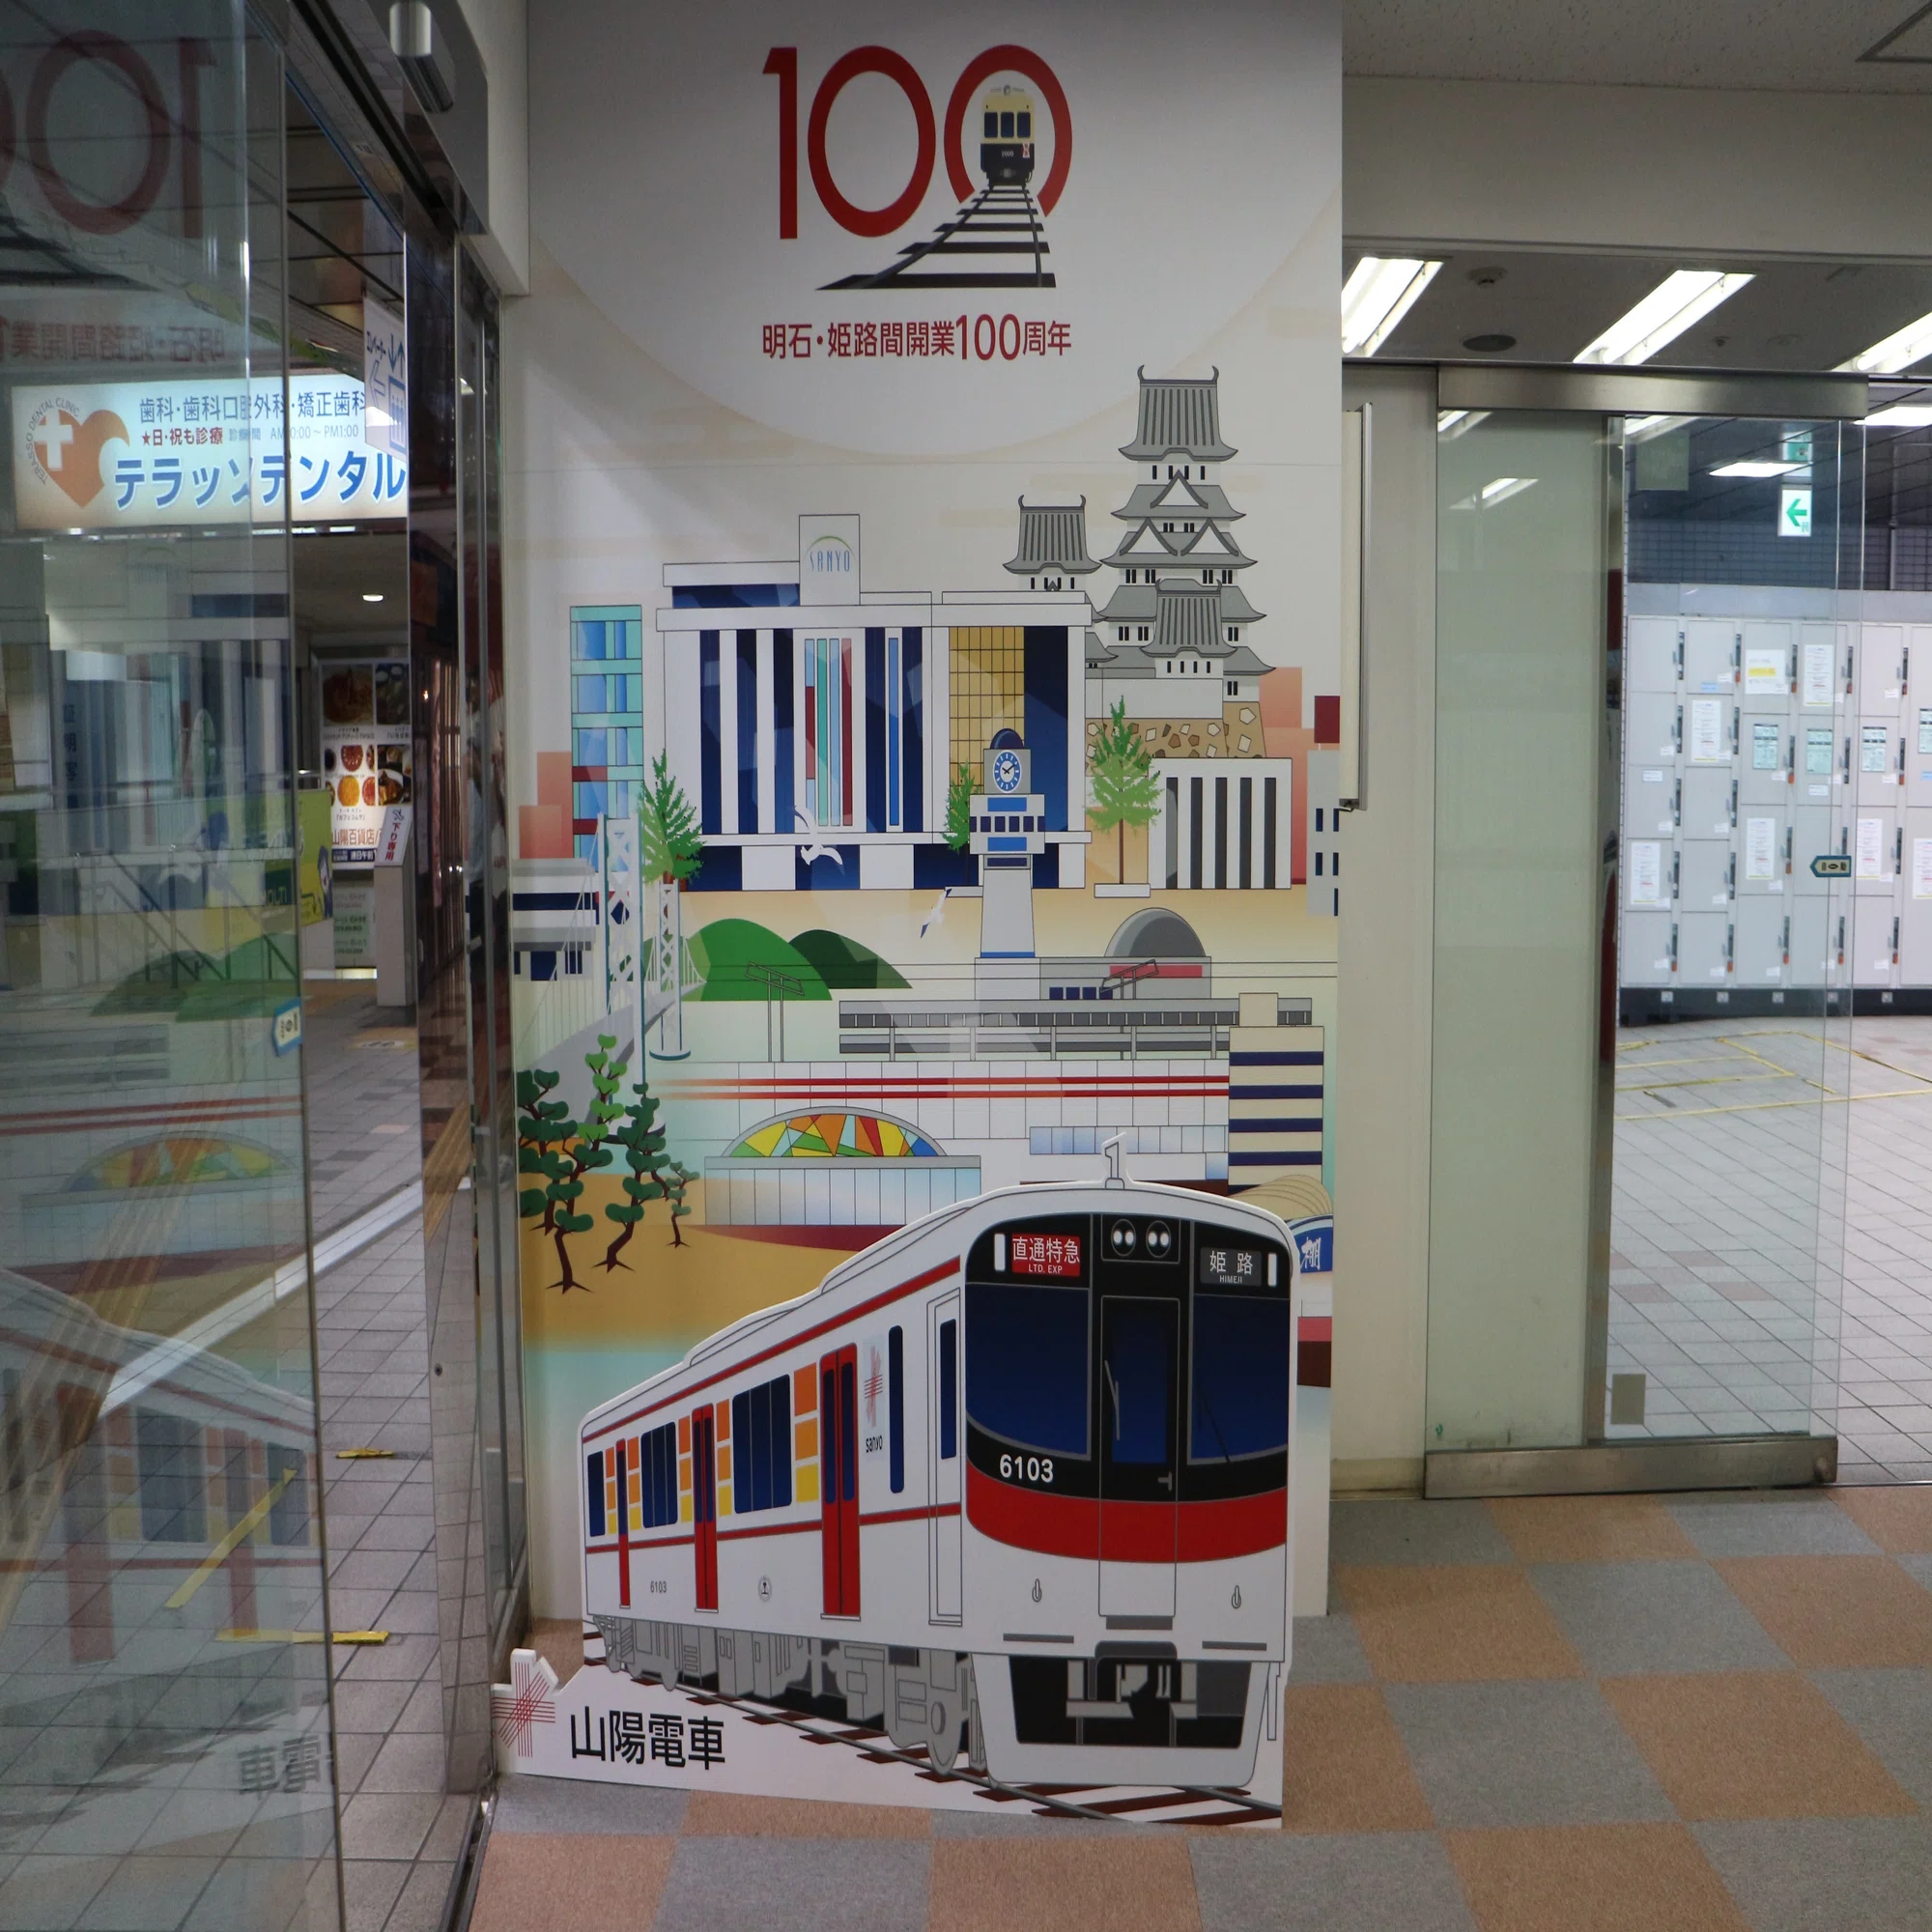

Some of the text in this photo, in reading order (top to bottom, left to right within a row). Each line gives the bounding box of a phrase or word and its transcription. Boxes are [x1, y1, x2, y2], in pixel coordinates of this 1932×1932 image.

[761, 43, 1073, 240] 100
[761, 313, 1073, 361] 明石・姫路間開業100周年
[28, 399, 54, 432] DENTAL
[55, 397, 80, 417] CLINIC
[810, 549, 850, 573] SANYO
[1012, 1236, 1081, 1264] 直通特急
[1028, 1264, 1063, 1274] LTD. EXP
[1219, 1274, 1243, 1284] HIMEJI
[999, 1454, 1055, 1484] 6103
[650, 1580, 668, 1594] 6103
[570, 1705, 725, 1771] 山陽電車
